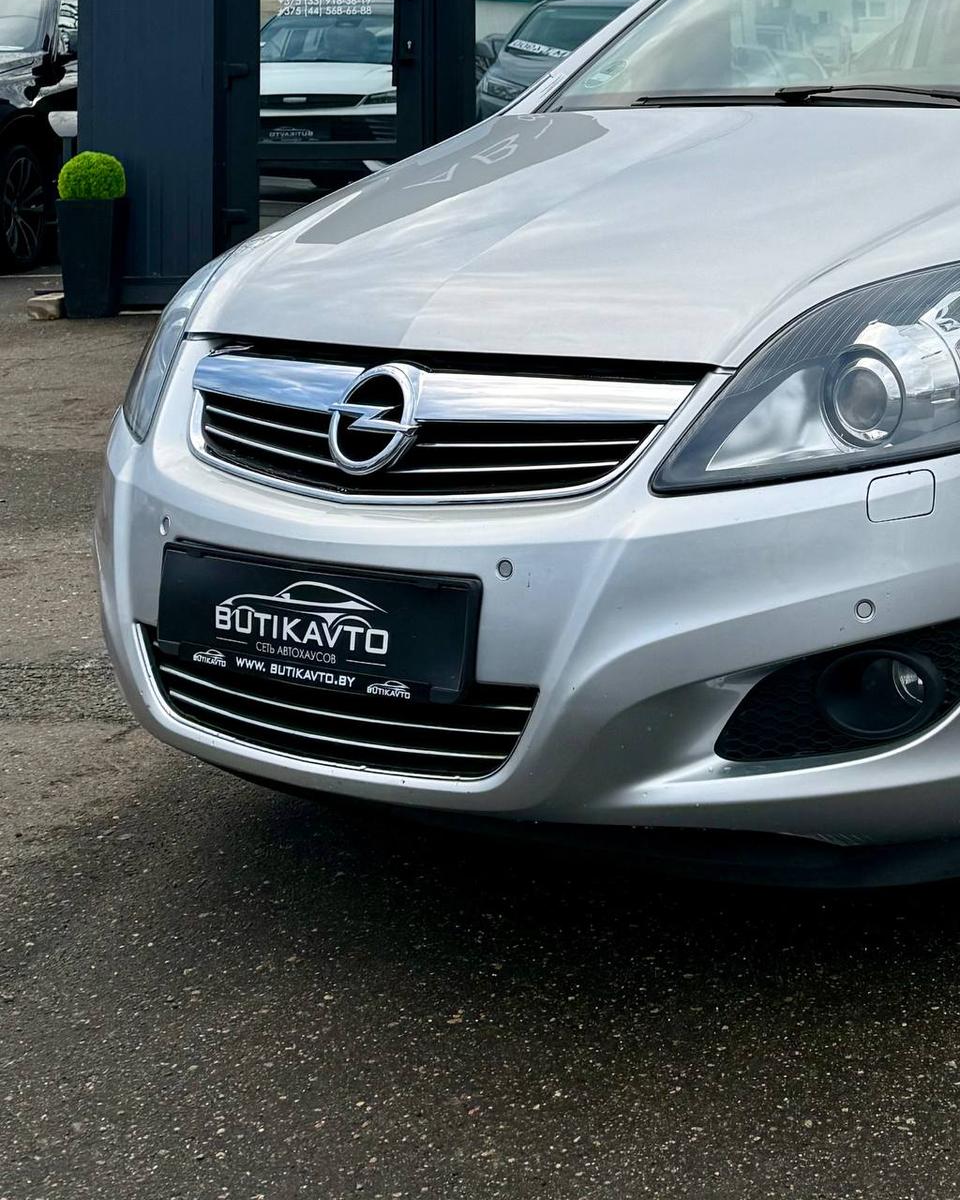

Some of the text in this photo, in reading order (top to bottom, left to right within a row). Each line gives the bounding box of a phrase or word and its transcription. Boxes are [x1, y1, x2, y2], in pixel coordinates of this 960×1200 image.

[304, 6, 322, 17] (44)
[215, 606, 388, 655] BUTIKAVTO
[192, 654, 227, 668] BUTIKAVTO
[255, 641, 337, 664] СЕТЬ АВТОХАУСОВ
[235, 656, 356, 688] WWW. BUTIKAVTO.BY
[367, 686, 411, 700] BUTIKAVTO
